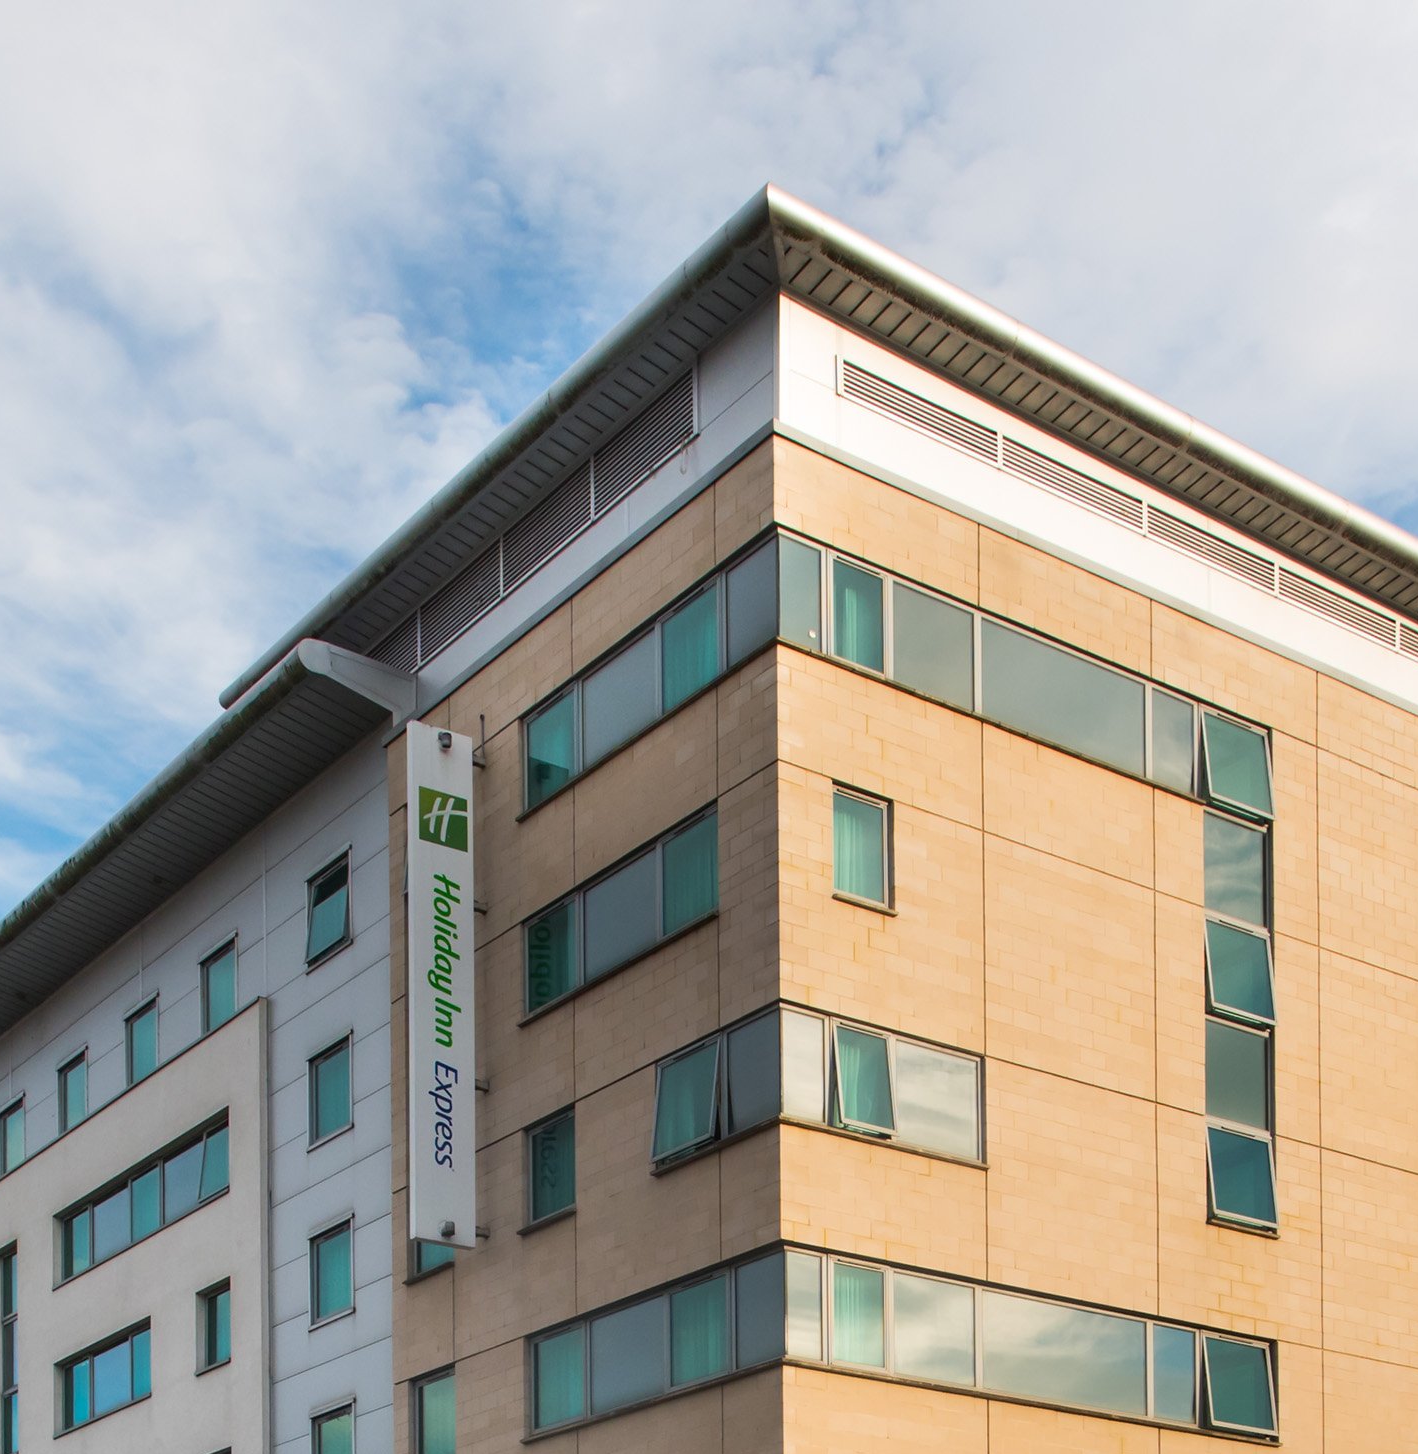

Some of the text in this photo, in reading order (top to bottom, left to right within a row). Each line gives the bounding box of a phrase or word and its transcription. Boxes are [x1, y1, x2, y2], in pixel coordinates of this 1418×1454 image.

[427, 873, 462, 1168] Holiday Inn Express
